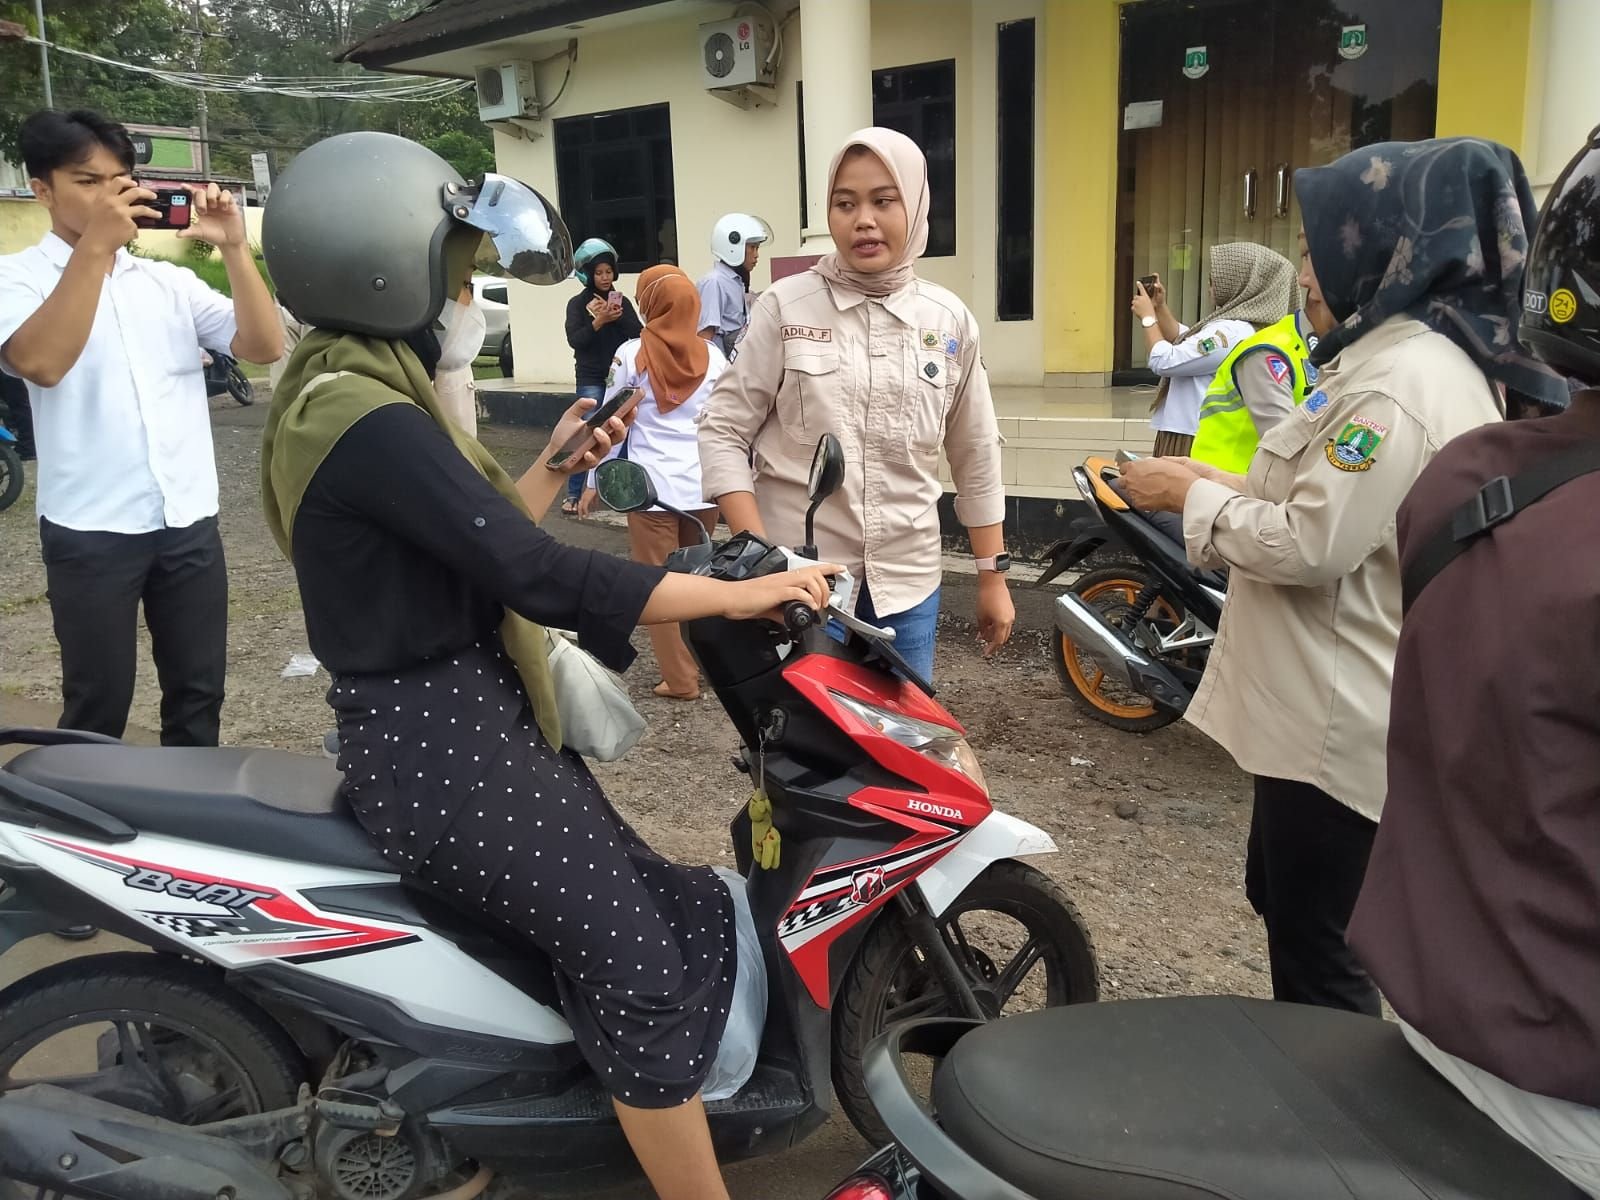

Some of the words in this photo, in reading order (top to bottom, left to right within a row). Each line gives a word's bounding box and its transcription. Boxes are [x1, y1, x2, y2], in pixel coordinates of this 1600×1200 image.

[739, 41, 750, 51] LG
[1523, 293, 1544, 311] DOT
[783, 327, 815, 338] ADILA
[907, 799, 963, 820] HONDA
